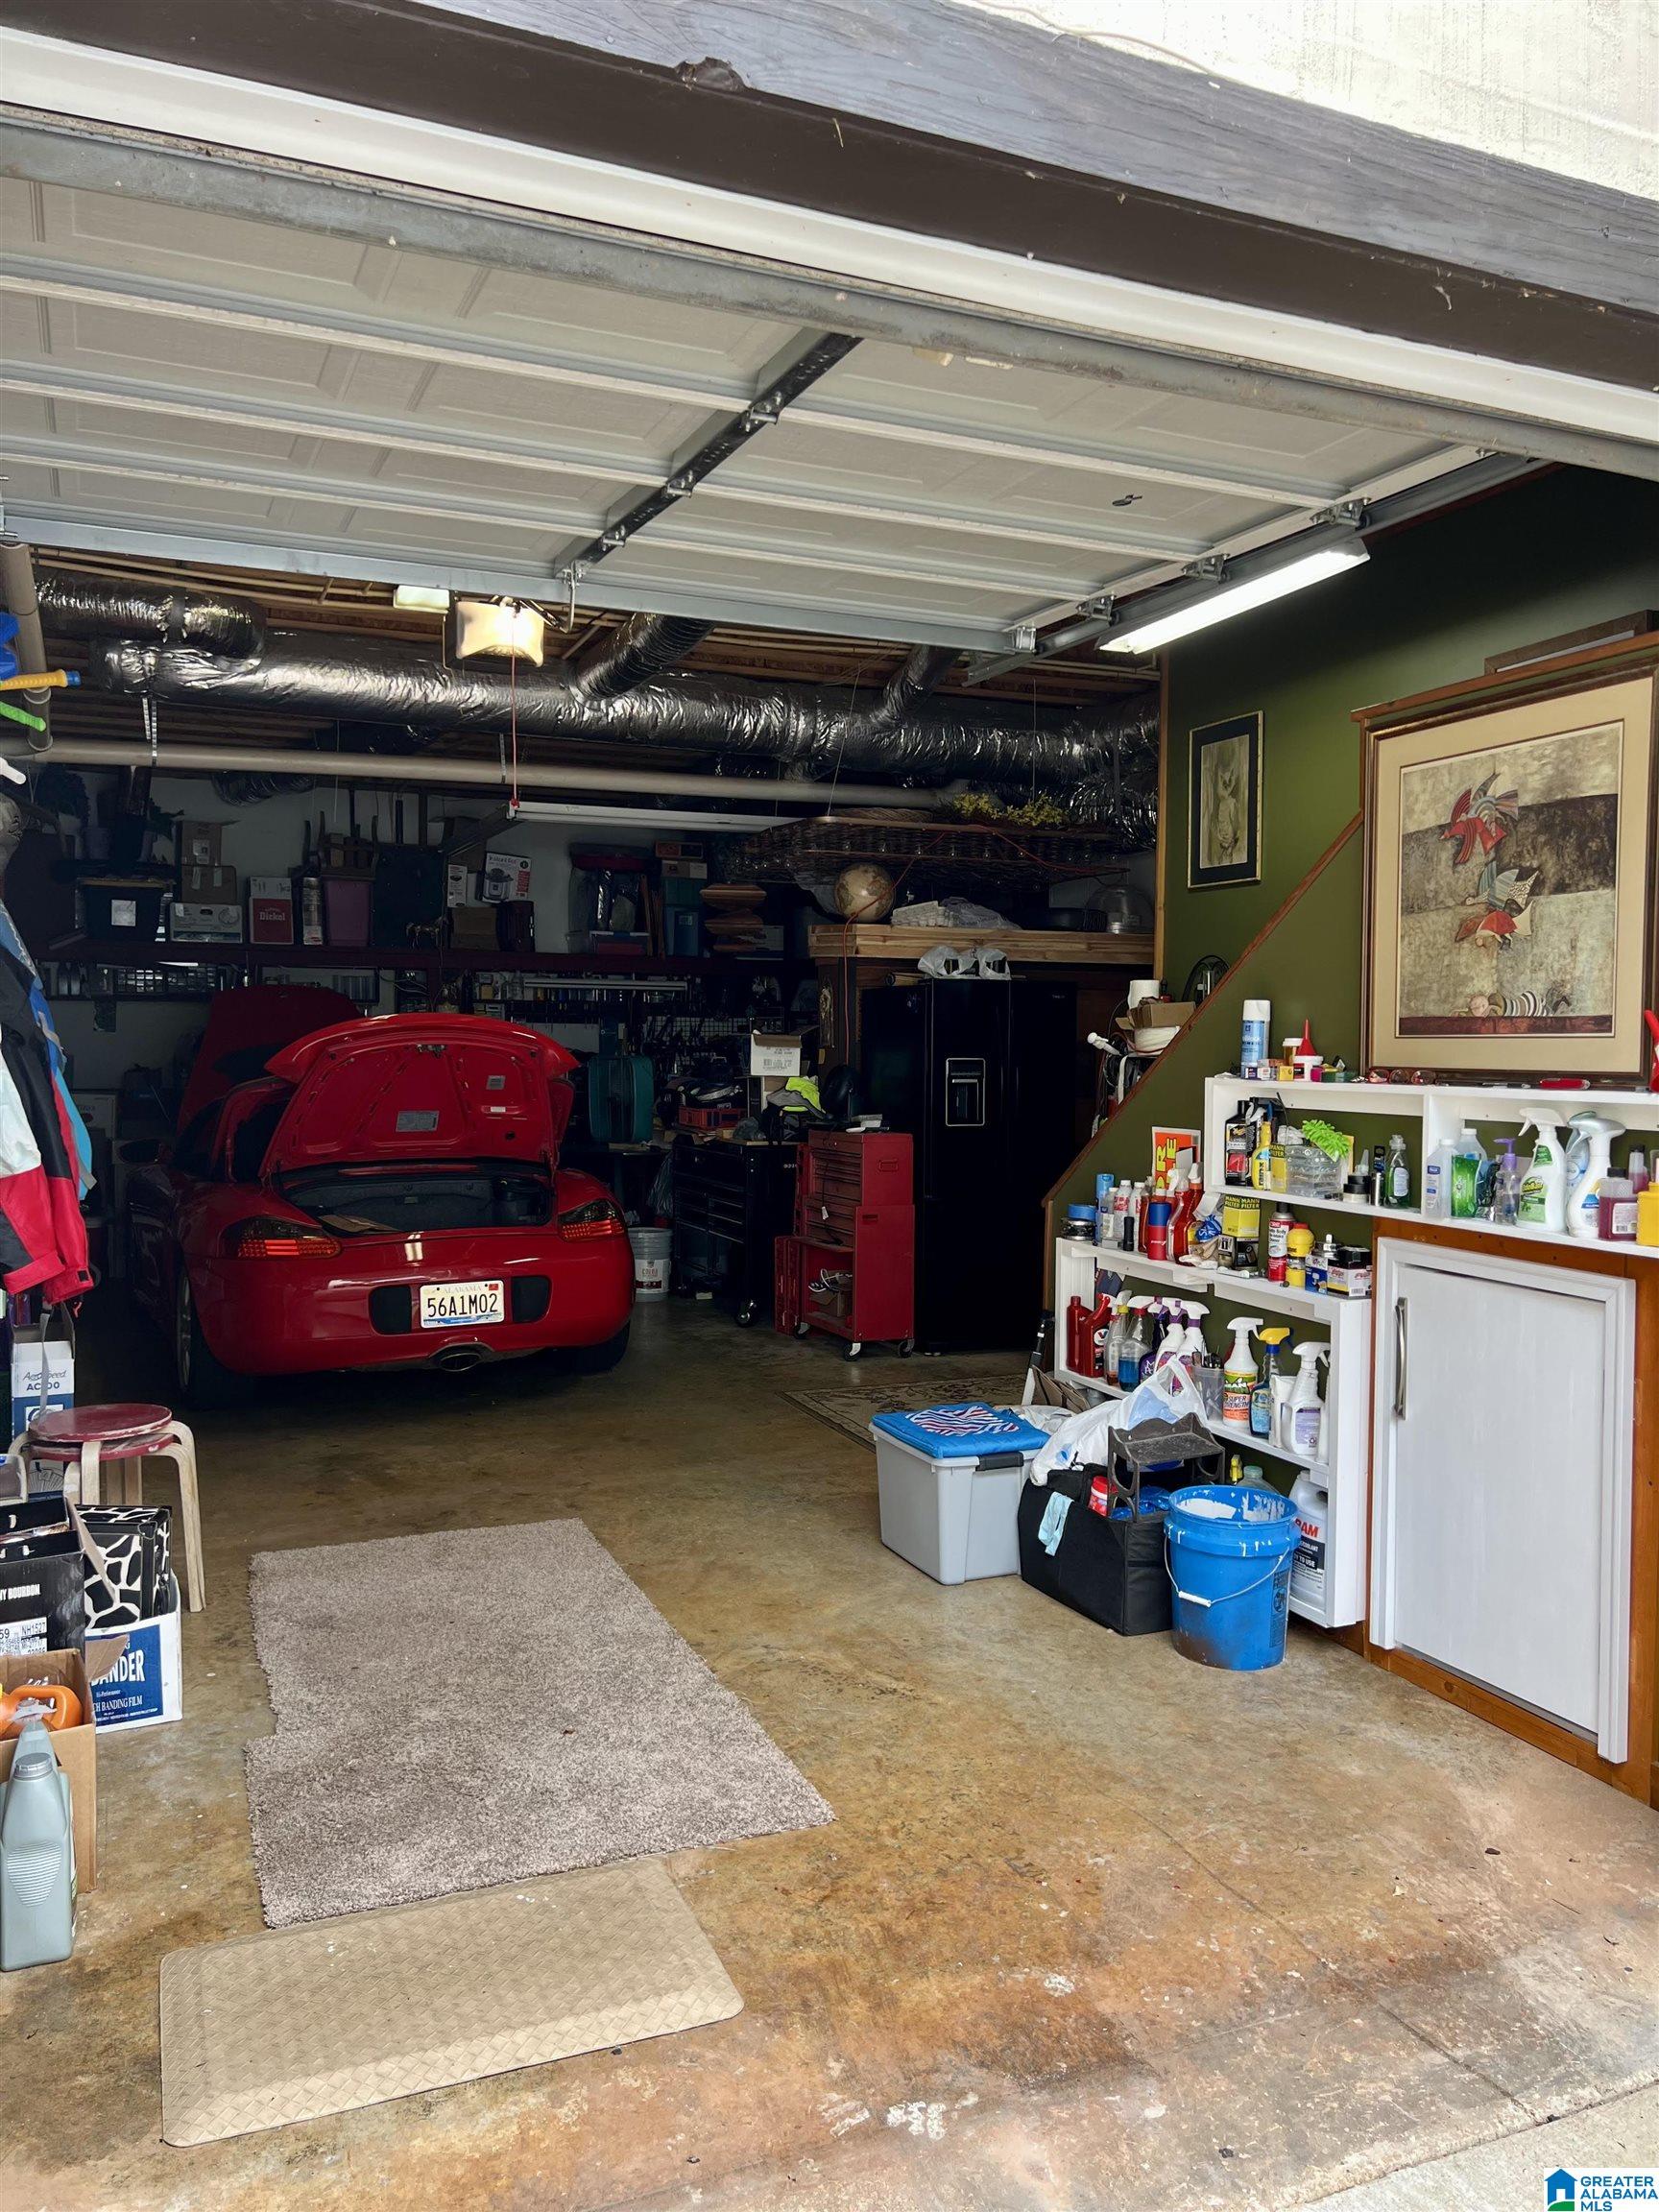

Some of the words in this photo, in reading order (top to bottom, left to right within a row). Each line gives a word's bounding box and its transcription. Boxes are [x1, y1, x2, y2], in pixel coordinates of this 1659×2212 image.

[26, 1381, 60, 1391] AC00
[101, 1696, 129, 1712] BANDING
[129, 1695, 143, 1707] FILM
